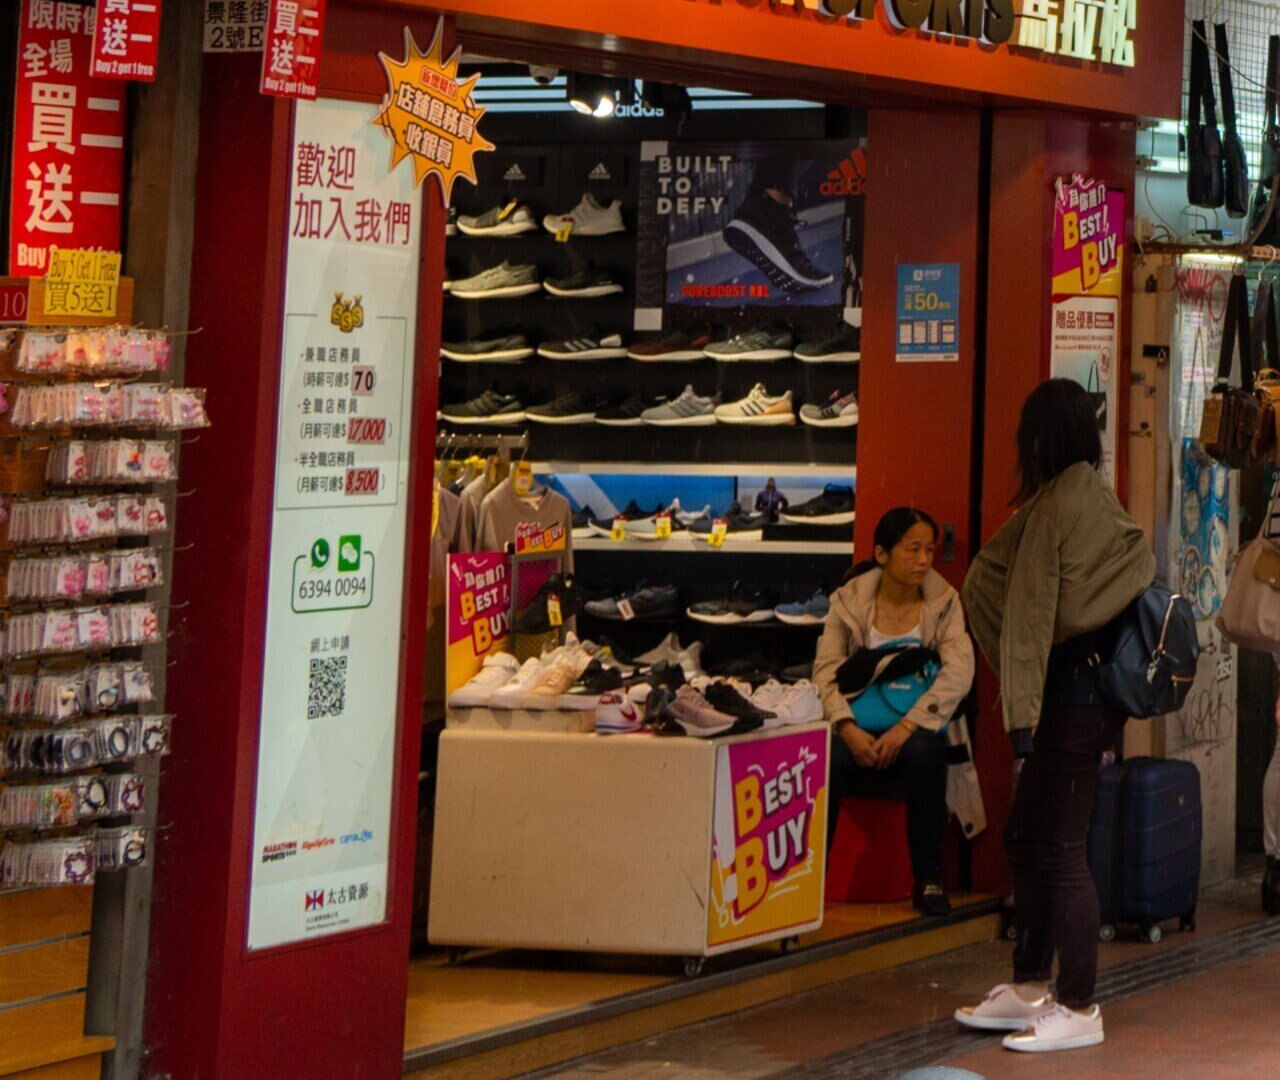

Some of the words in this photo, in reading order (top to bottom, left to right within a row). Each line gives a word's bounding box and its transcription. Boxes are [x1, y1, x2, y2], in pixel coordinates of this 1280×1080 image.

[101, 18, 154, 57] 送一
[273, 0, 320, 38] 買二
[22, 38, 73, 78] 全場
[270, 38, 315, 77] 送一
[27, 82, 124, 156] 買二
[296, 142, 356, 191] 歡迎
[657, 155, 732, 175] BUILT
[25, 162, 120, 235] 送一
[657, 196, 724, 215] DEFY
[658, 177, 692, 195] TO
[293, 192, 411, 245] 加入我們
[17, 242, 46, 269] Buy
[46, 280, 115, 315] 買5送1
[914, 292, 938, 311] 50
[299, 579, 331, 599] 6394
[335, 577, 367, 597] 0094
[736, 760, 805, 838] BEST
[736, 809, 807, 915] BUY
